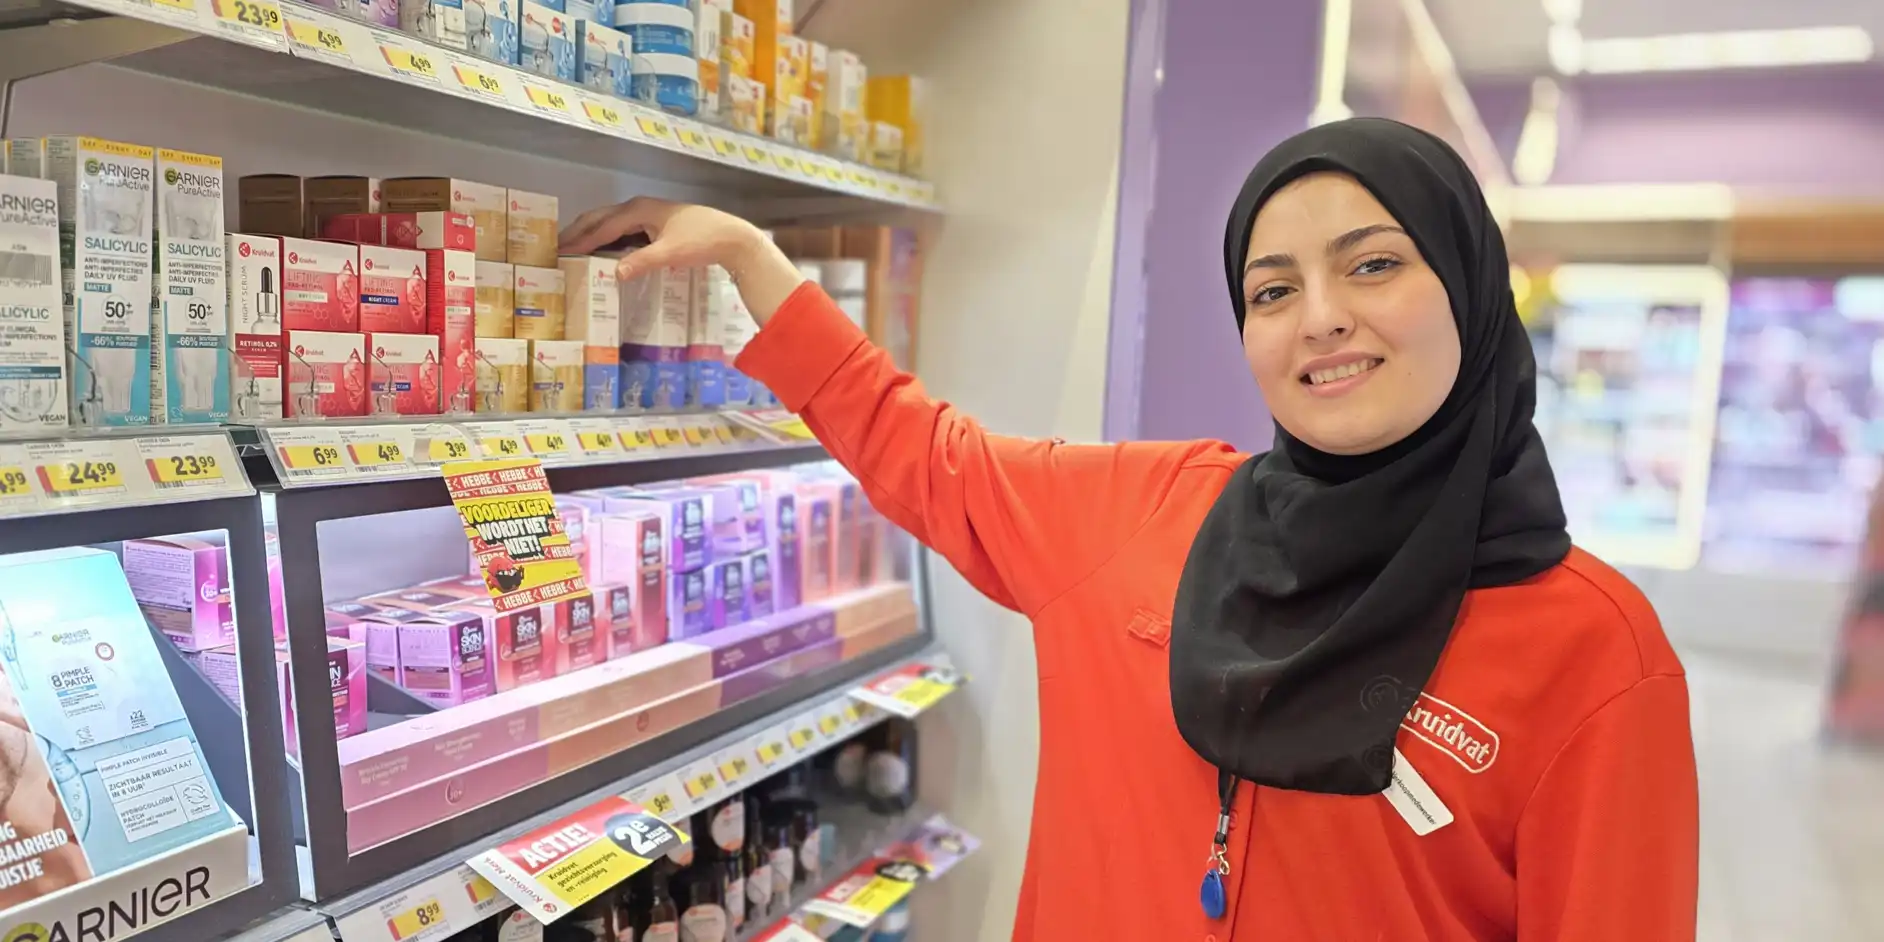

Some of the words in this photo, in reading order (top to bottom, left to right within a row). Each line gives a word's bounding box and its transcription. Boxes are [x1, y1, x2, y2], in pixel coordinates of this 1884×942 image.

[235, 0, 279, 26] 23.99
[317, 30, 343, 49] 4.99
[410, 54, 432, 72] 4.99
[85, 158, 150, 182] GARNIER
[165, 168, 220, 189] GARNIER
[177, 184, 220, 199] PureActive
[84, 236, 148, 254] SALICYLIC
[168, 242, 222, 258] SALICYLIC
[84, 271, 104, 280] DAILY
[118, 273, 139, 282] FLUID
[90, 335, 114, 346] -66%
[176, 336, 198, 347] -66%
[239, 340, 265, 348] RETINOL
[124, 415, 148, 423] VEGAN
[312, 446, 338, 465] 6.99
[378, 444, 400, 462] 4.99
[448, 442, 467, 458] 3.99
[500, 440, 518, 455] 4.99
[67, 461, 117, 485] 24.99
[170, 455, 216, 477] 23.99
[460, 472, 493, 489] HEBBE
[500, 467, 529, 483] HEBBE
[460, 498, 552, 525] VOORDELIGER
[475, 519, 526, 541] WORDT
[527, 516, 549, 534] HET
[503, 535, 542, 556] NIET!
[503, 591, 535, 609] HEBBE
[540, 580, 569, 597] HEBBE
[51, 674, 63, 688] 8
[60, 666, 91, 679] PIMPLE
[63, 674, 95, 688] PATCH
[122, 757, 141, 767] PATCH
[141, 748, 169, 762] INVISIBLE
[108, 772, 152, 791] ZICHTBAAR
[151, 759, 193, 778] RESULTAAT
[111, 790, 121, 798] IN
[123, 813, 145, 824] PATCH
[518, 822, 599, 869] ACTIE!
[484, 857, 506, 875] Merk
[547, 862, 579, 881] Kruidvat
[557, 851, 618, 888] gezichtsverzorging
[504, 874, 543, 903] Kruidvat
[565, 884, 576, 893] en
[575, 867, 609, 887] -reiniging
[416, 902, 440, 926] 8.99
